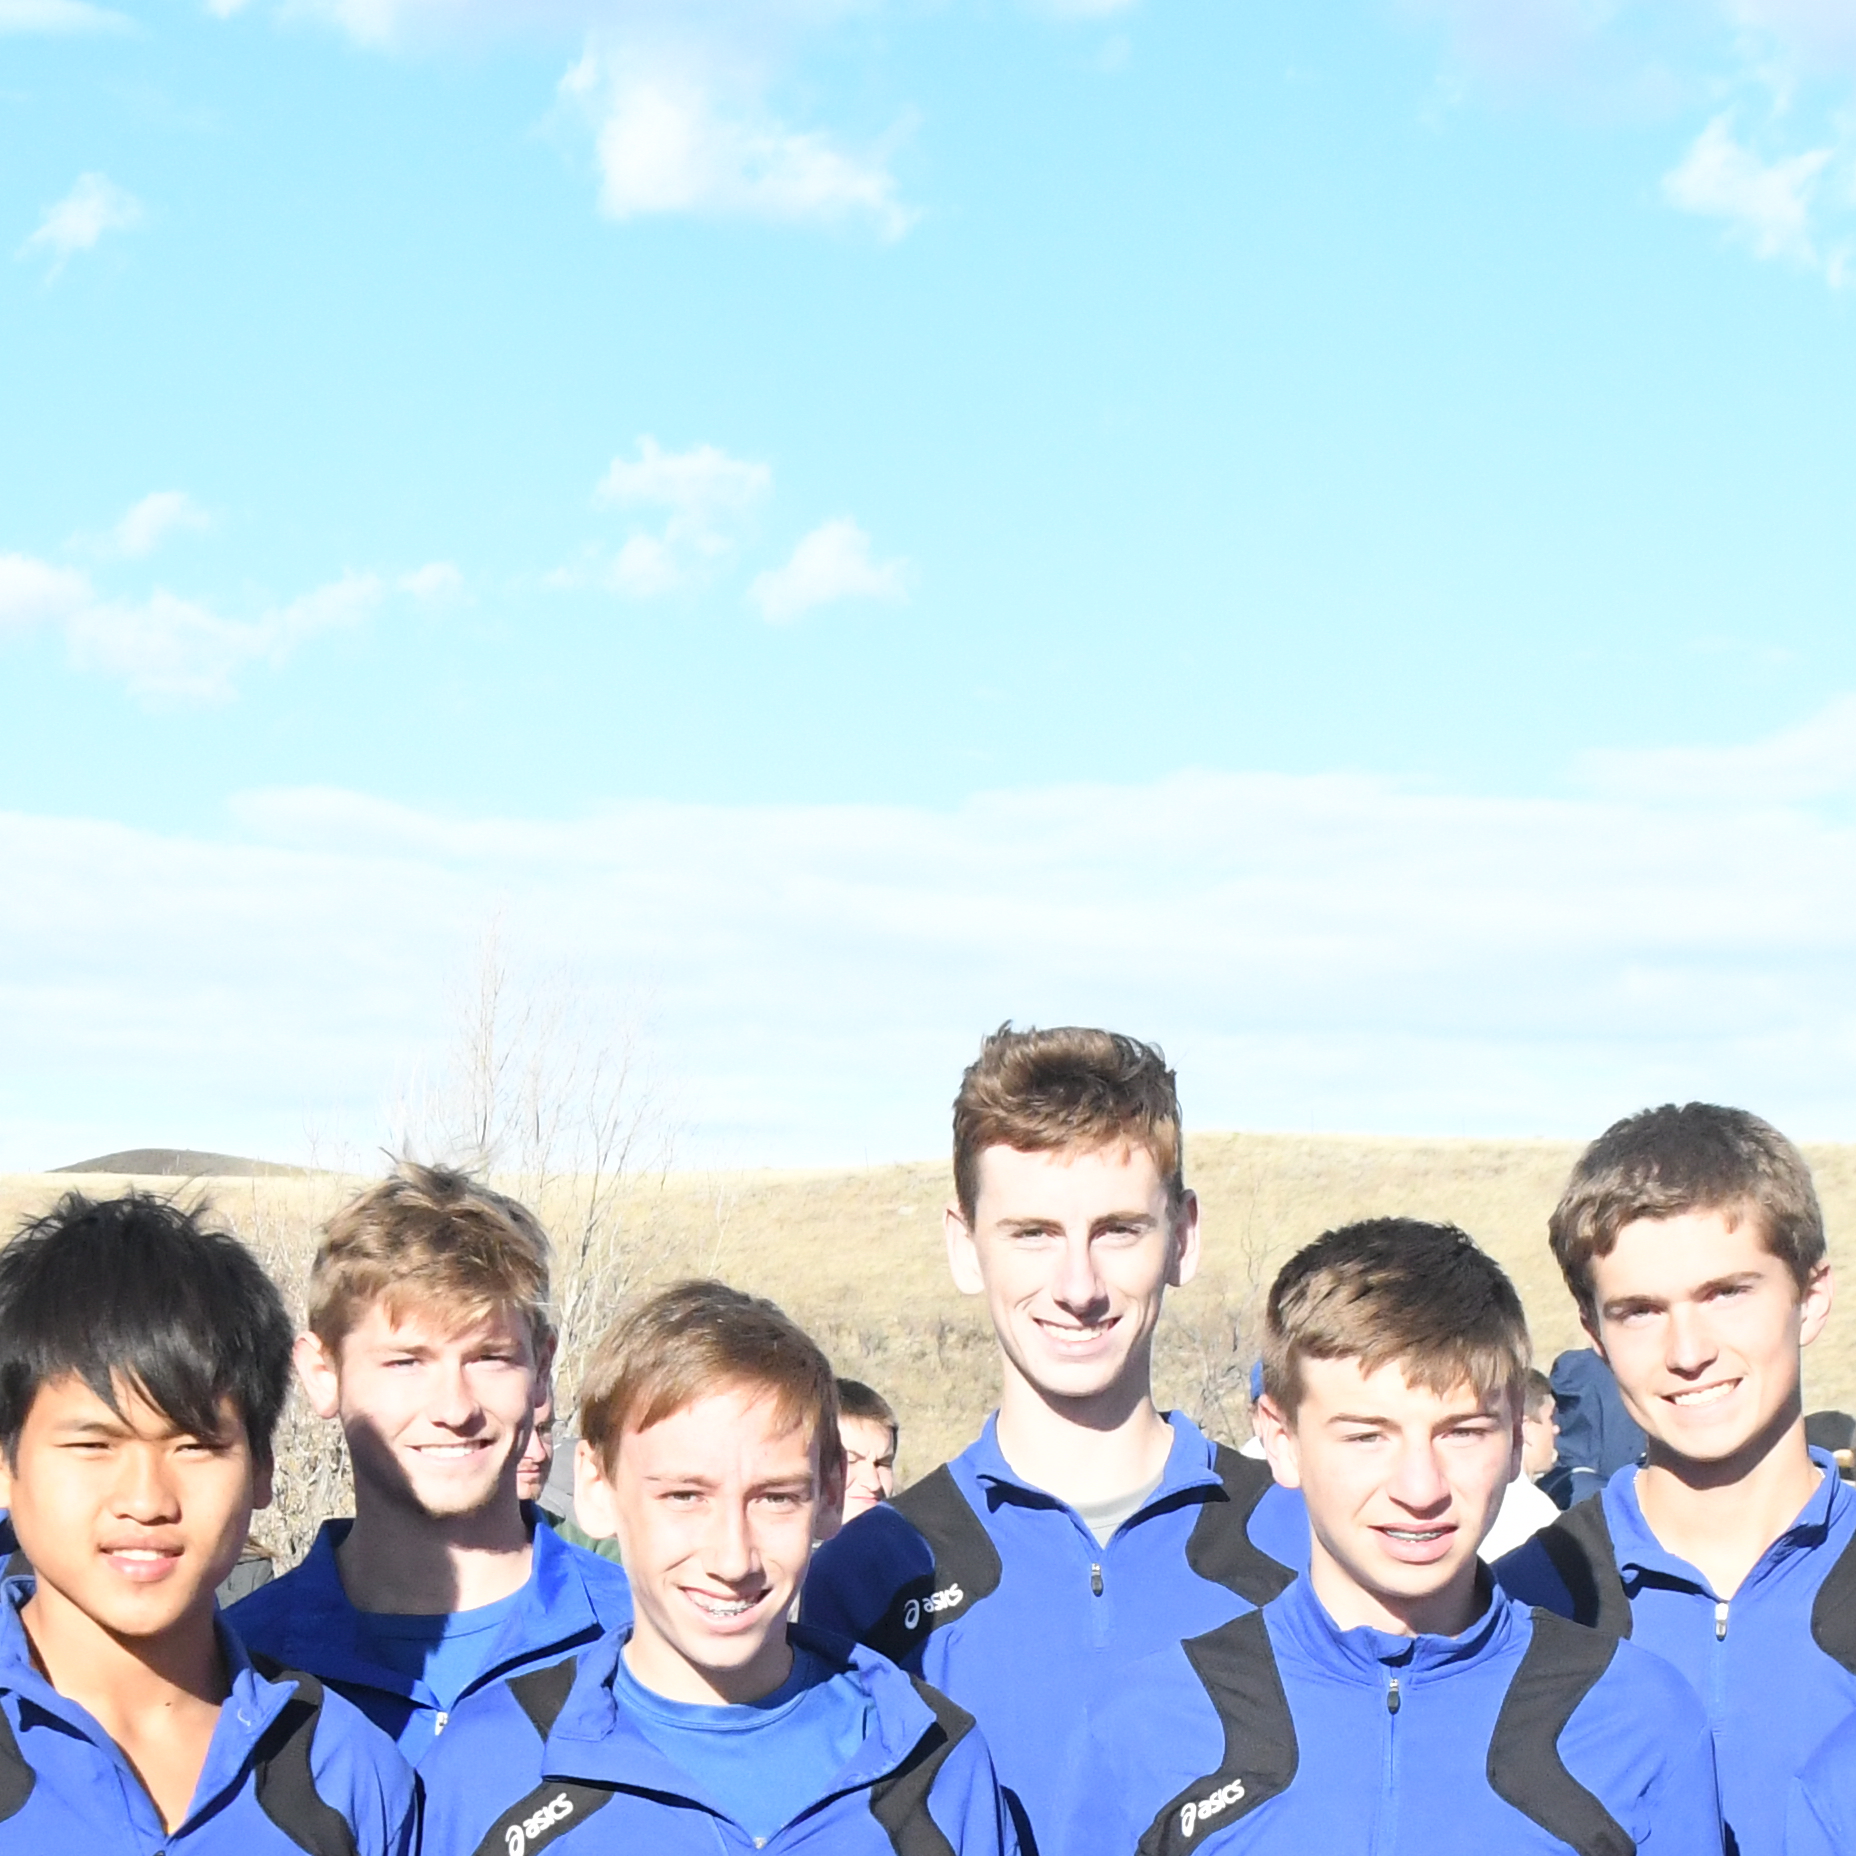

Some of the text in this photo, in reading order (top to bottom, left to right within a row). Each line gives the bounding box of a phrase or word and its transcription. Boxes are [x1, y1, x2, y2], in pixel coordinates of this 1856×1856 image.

[922, 1583, 964, 1613] asics
[523, 1792, 574, 1840] asics
[1198, 1778, 1245, 1820] asics
